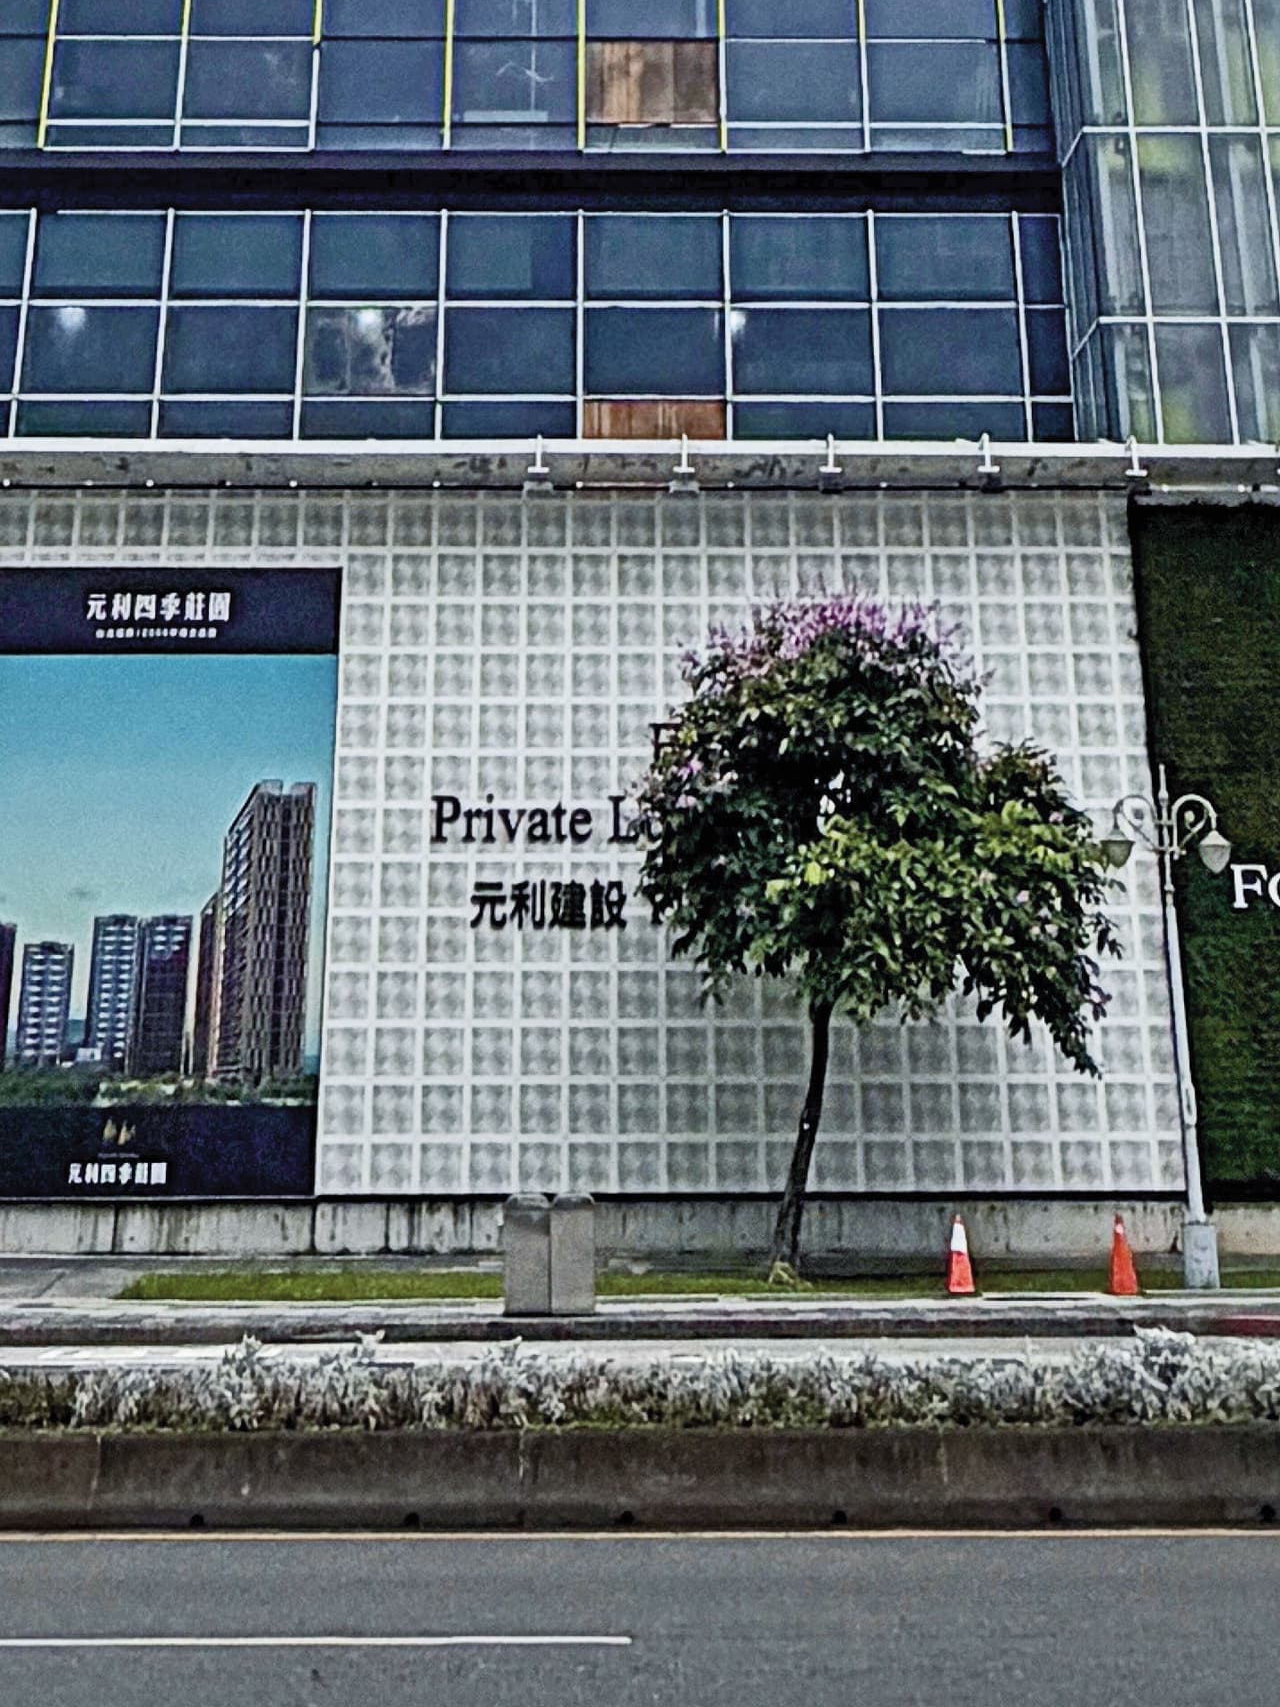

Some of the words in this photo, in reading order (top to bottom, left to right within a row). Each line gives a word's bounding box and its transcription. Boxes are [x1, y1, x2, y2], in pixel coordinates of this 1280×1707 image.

[430, 793, 593, 844] Private
[470, 878, 627, 930] 元利建設
